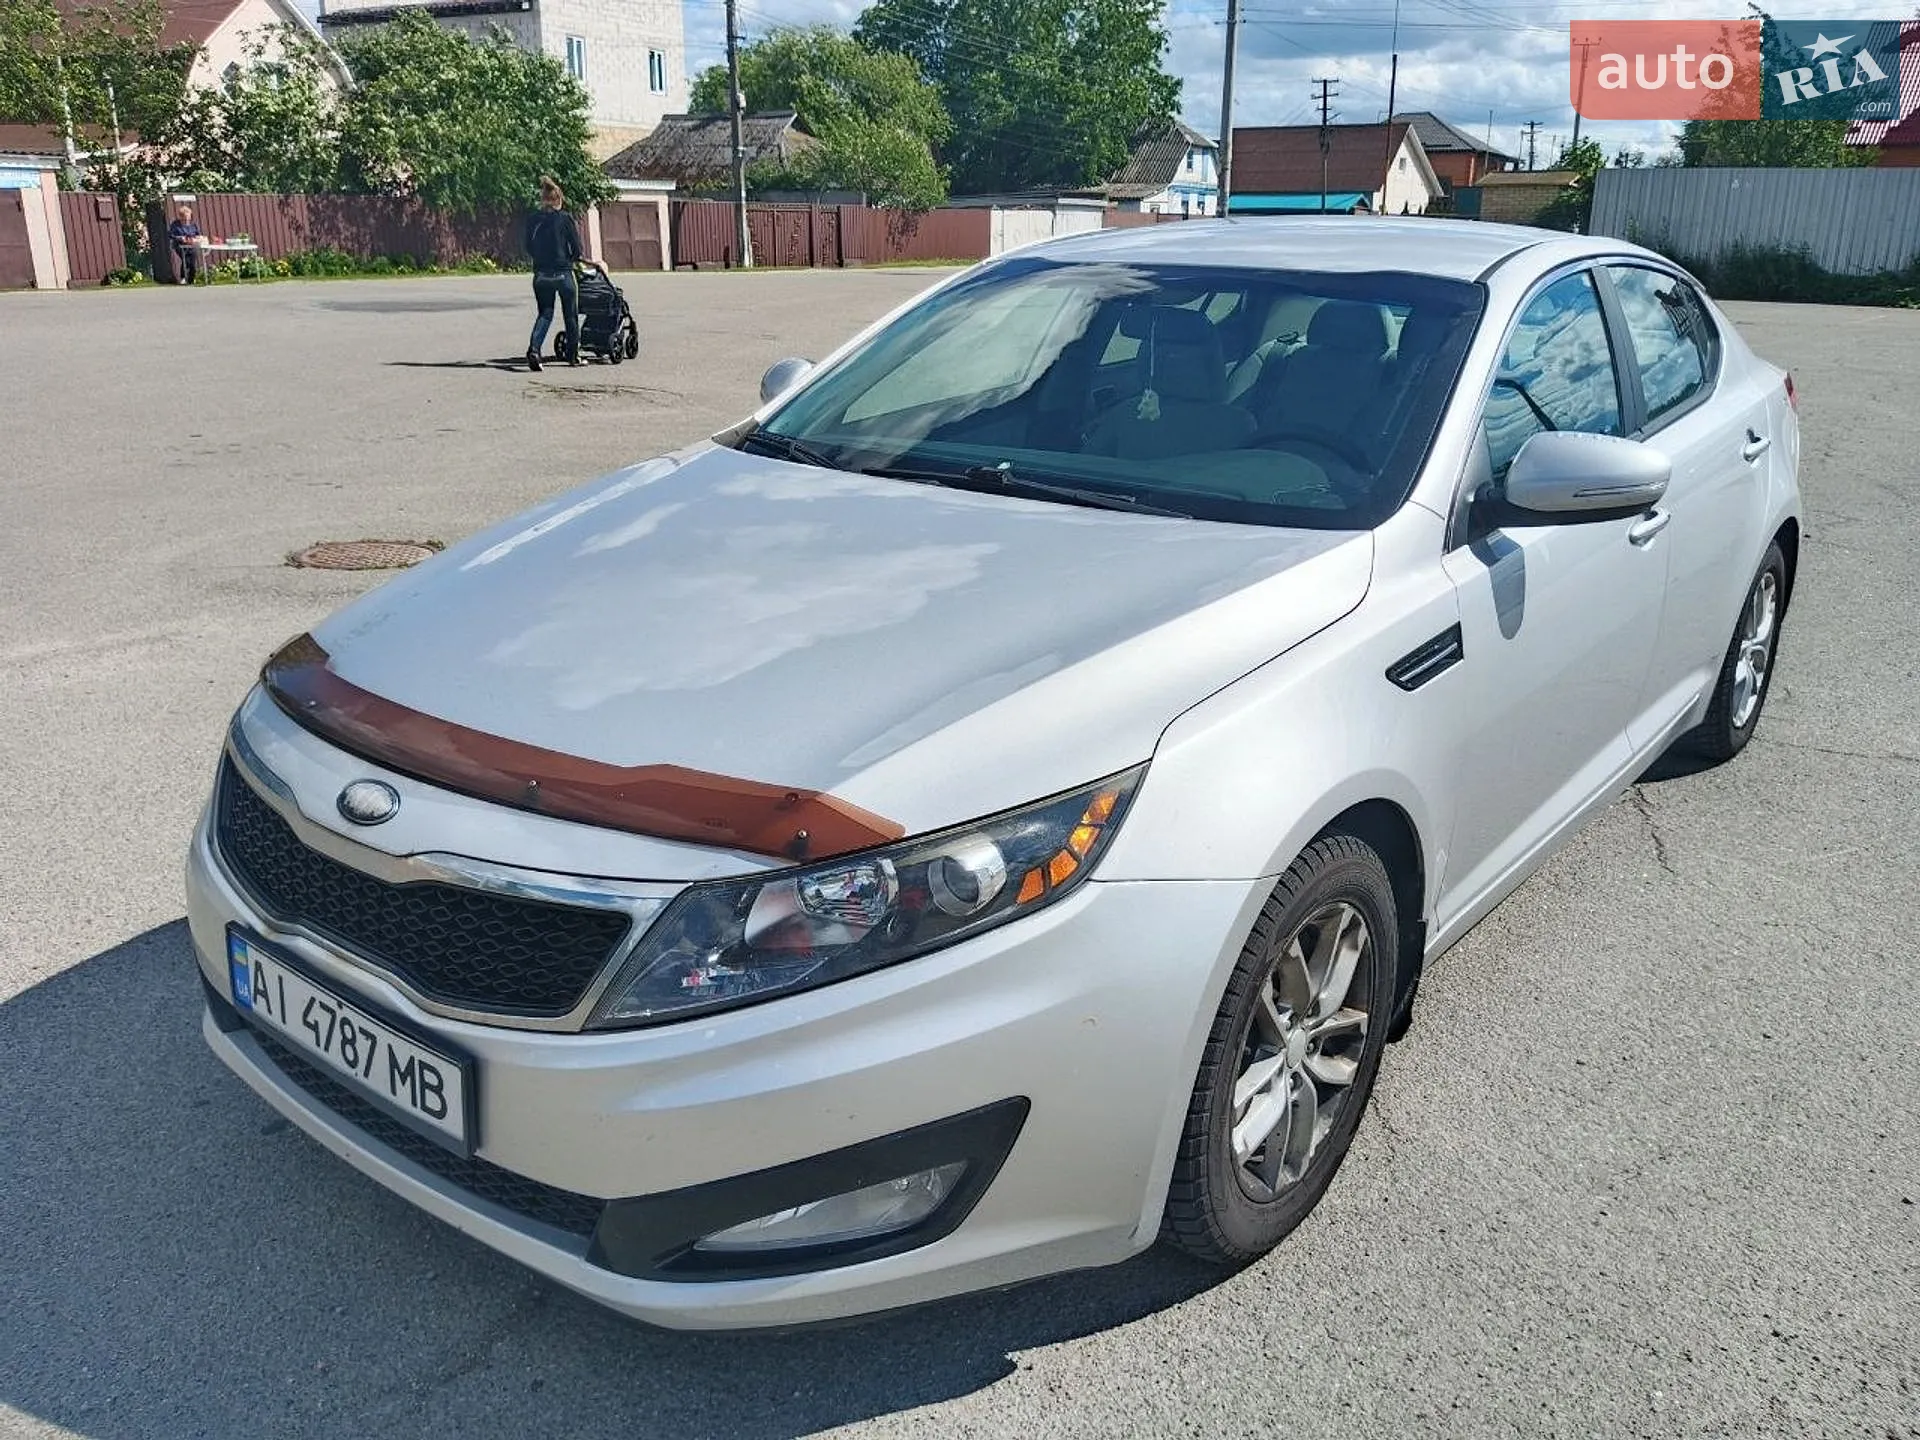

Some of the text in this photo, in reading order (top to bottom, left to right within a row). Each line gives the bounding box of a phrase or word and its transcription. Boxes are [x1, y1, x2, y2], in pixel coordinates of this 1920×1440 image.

[254, 959, 448, 1121] AI 4787 MB
